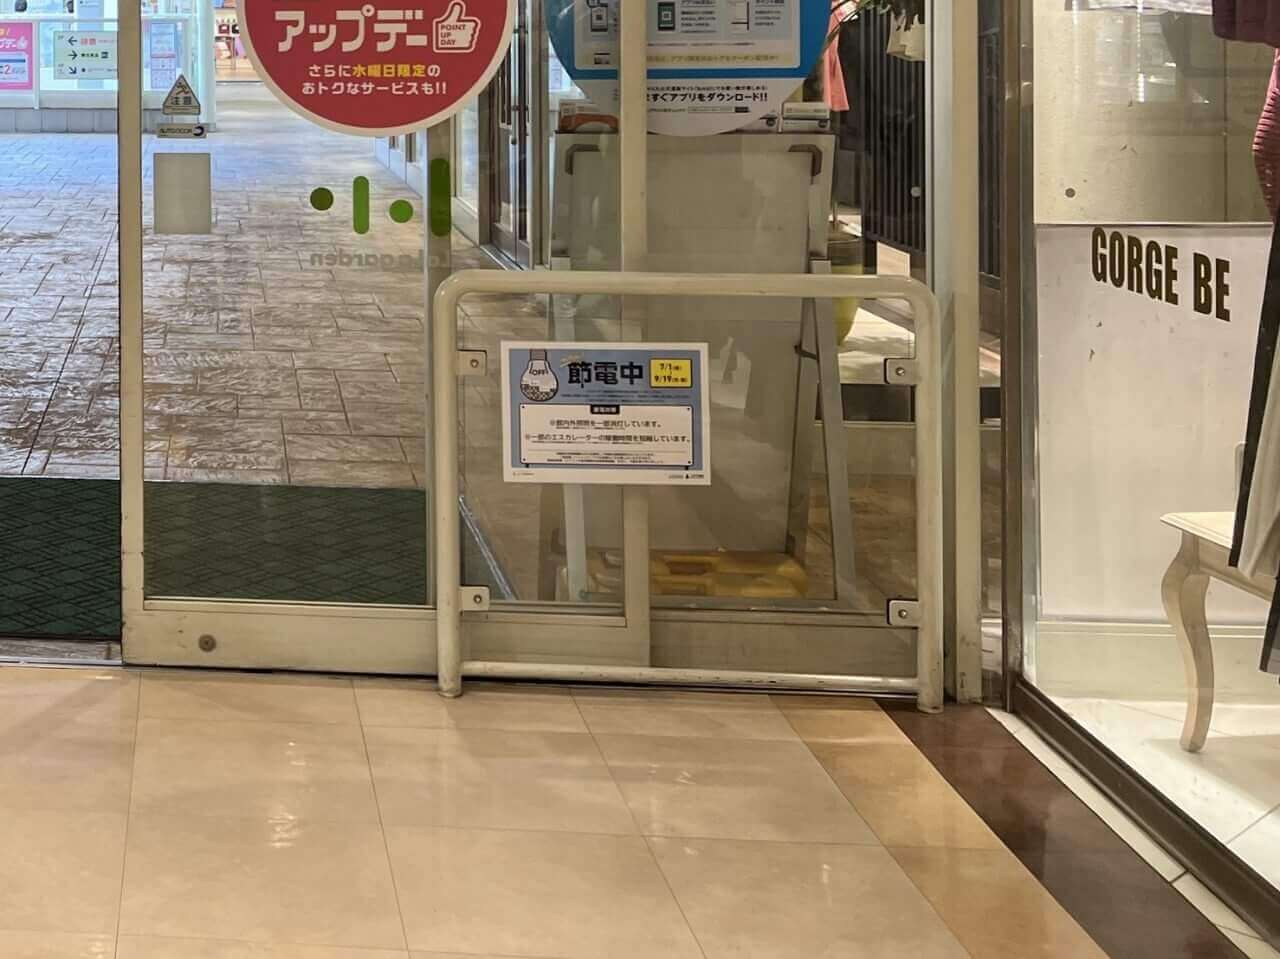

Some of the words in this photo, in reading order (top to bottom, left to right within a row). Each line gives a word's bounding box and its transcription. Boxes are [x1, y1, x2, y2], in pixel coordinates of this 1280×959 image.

[440, 23, 467, 31] POINT
[308, 64, 441, 78] さらに水曜日限定の
[1092, 227, 1178, 306] GORGE
[1193, 252, 1231, 322] BE
[567, 360, 644, 389] 節電中
